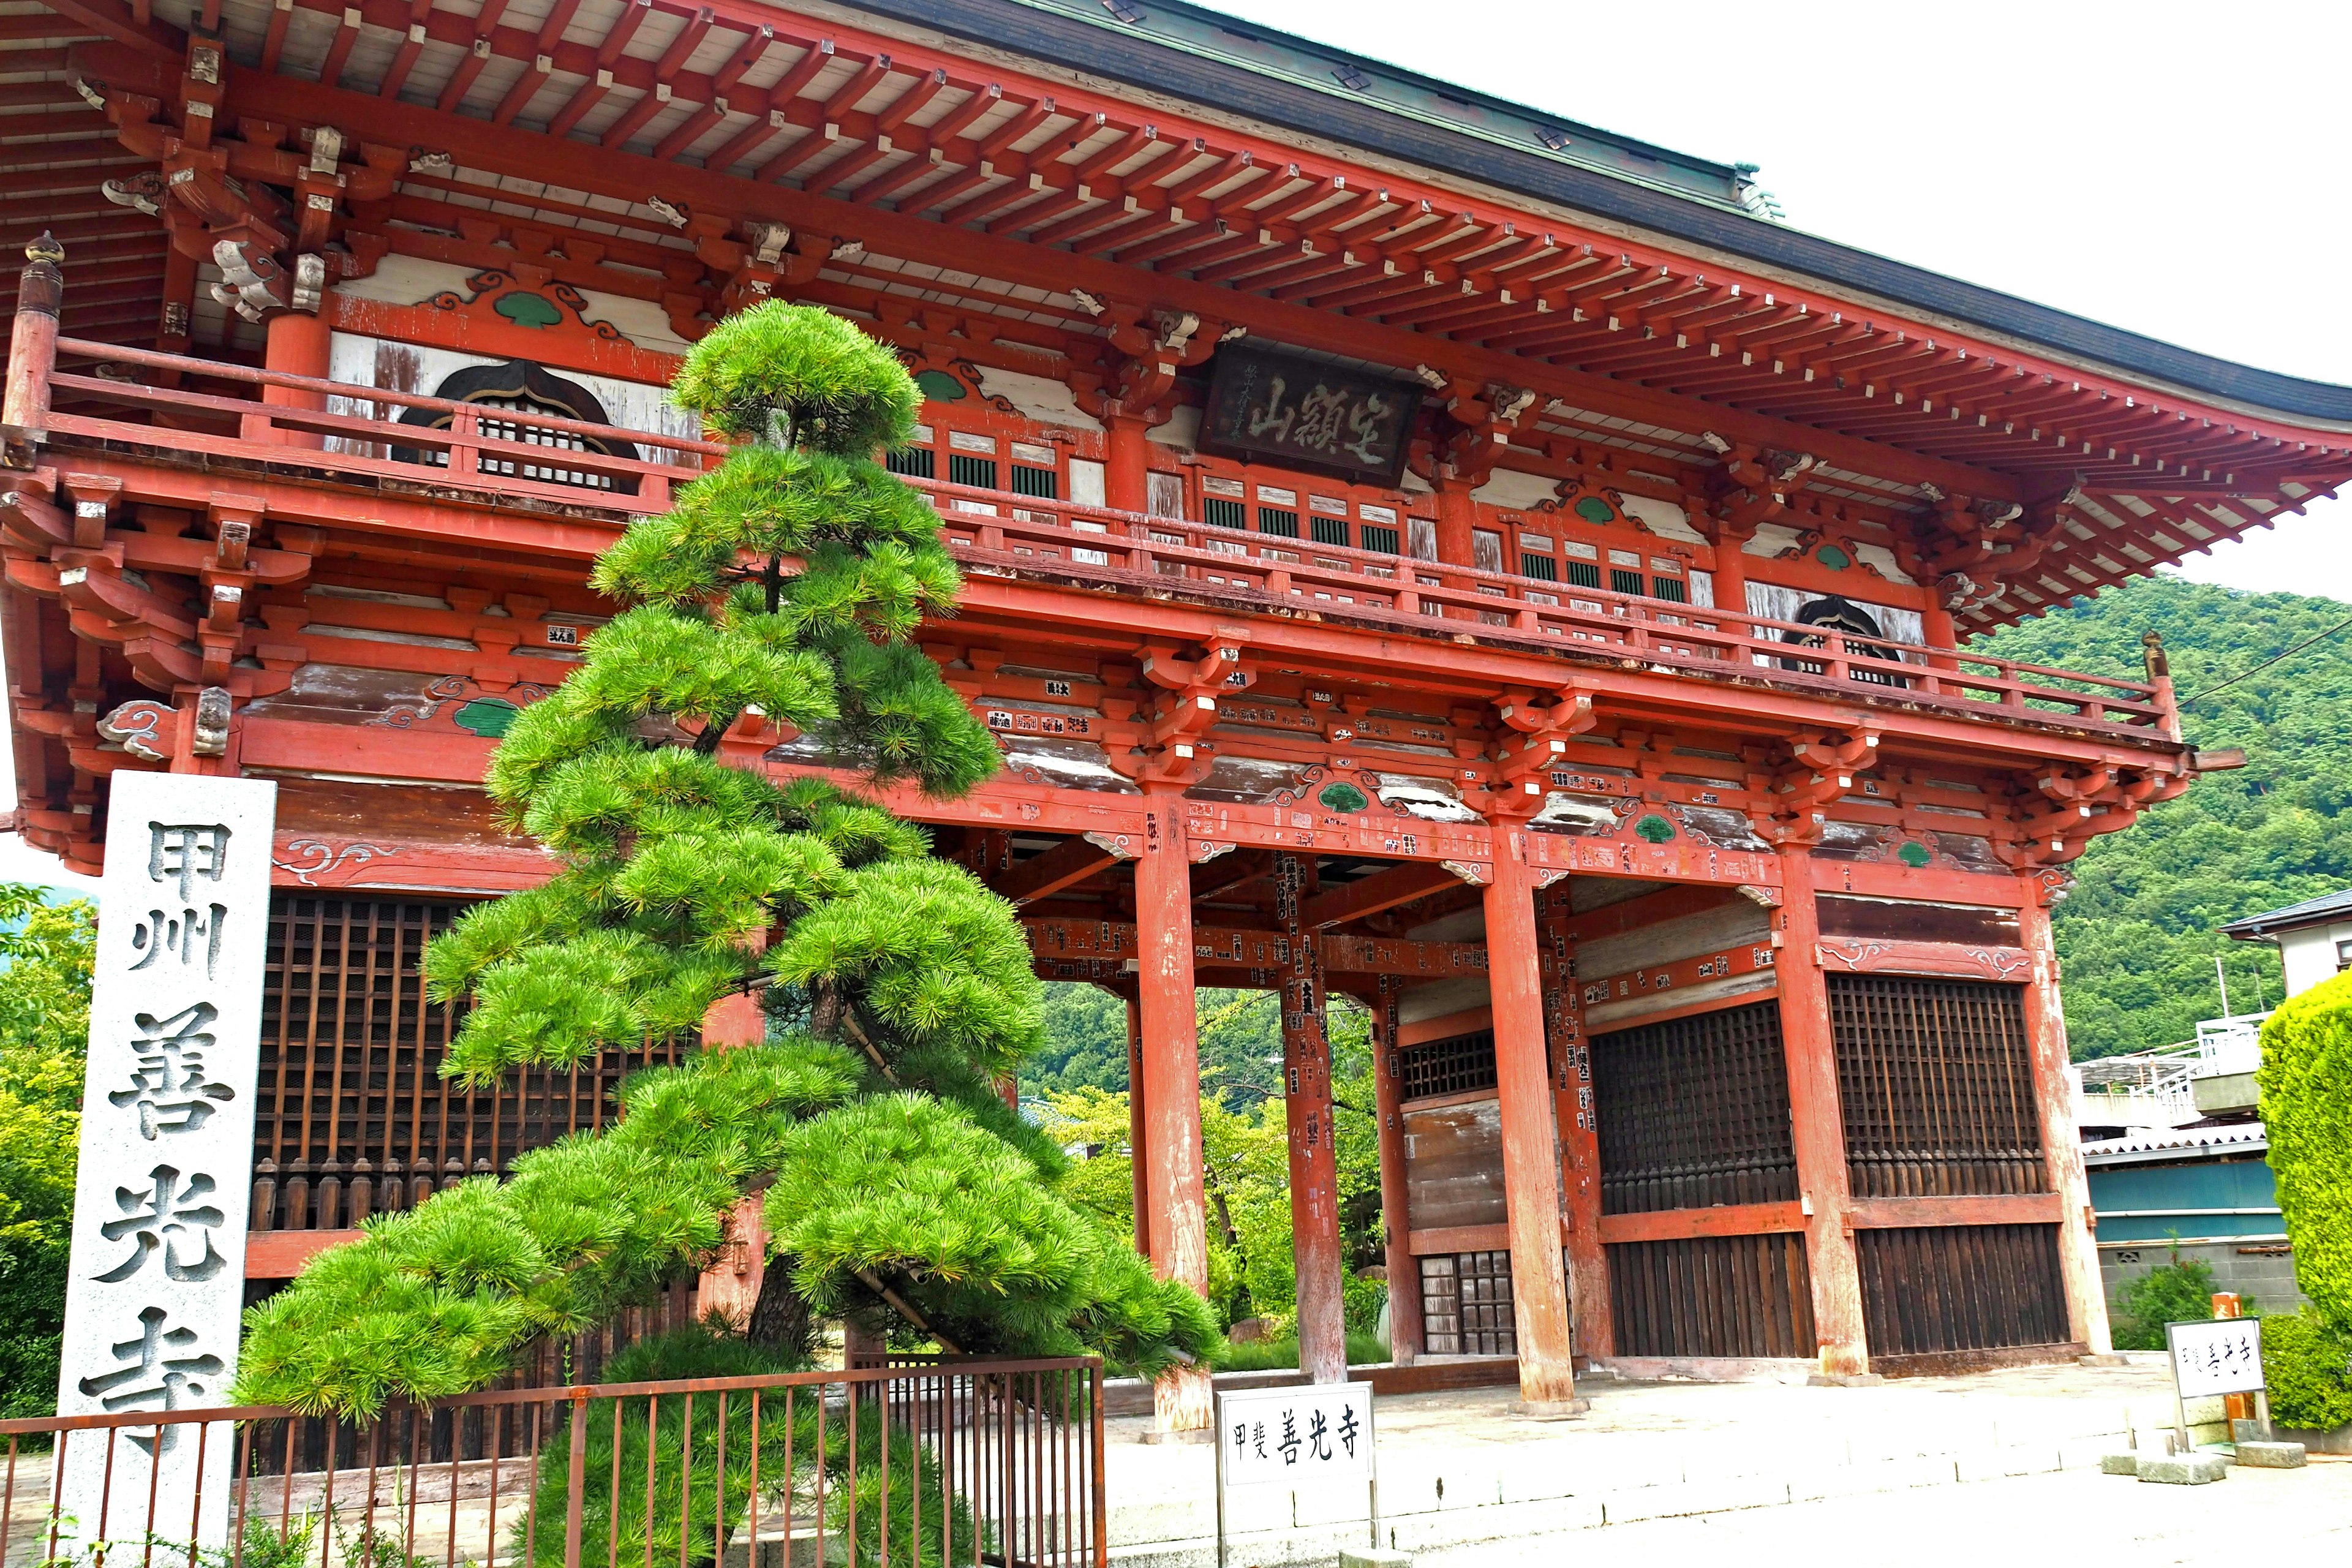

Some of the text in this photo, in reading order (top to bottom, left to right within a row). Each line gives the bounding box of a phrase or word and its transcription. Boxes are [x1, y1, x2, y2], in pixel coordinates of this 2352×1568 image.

[78, 820, 236, 1457] 甲州善光寺
[1234, 1404, 1359, 1466] 甲斐善光寺
